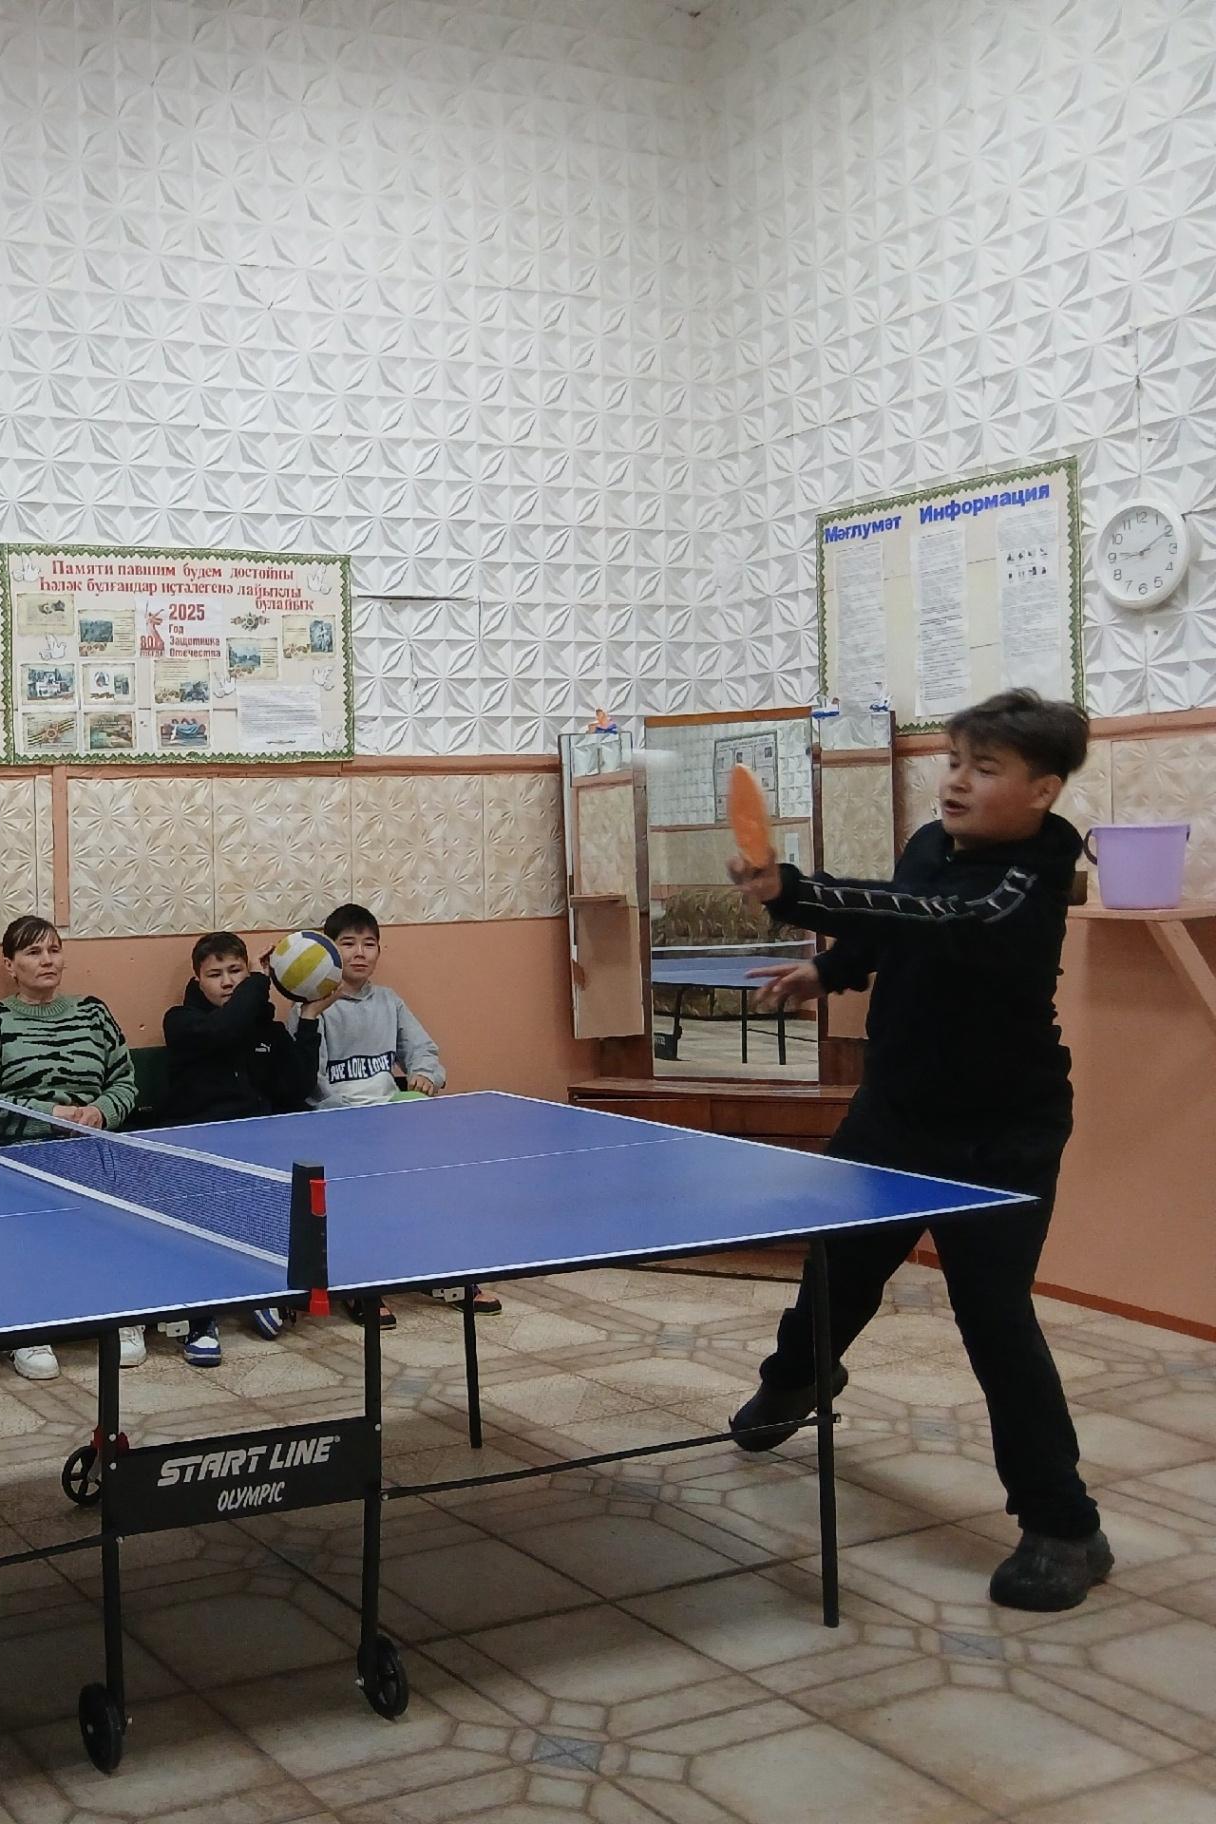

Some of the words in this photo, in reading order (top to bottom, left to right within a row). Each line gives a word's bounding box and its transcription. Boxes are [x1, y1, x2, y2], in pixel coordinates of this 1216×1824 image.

[919, 484, 1051, 524] Информация
[1136, 511, 1148, 523] 12
[1164, 525, 1173, 537] 2
[1111, 533, 1123, 545] 10
[1168, 543, 1178, 554] 3
[1107, 552, 1117, 564] 9
[52, 560, 114, 575] Памяти
[118, 563, 176, 577] павшим
[183, 562, 222, 581] будем
[230, 566, 294, 580] достойны
[1164, 561, 1173, 571] 4
[1113, 569, 1122, 581] 8
[1125, 580, 1133, 592] 7
[1153, 576, 1163, 588] 5
[1138, 583, 1148, 595] 6
[169, 603, 205, 621] 2025
[169, 623, 184, 634] Год
[347, 1058, 368, 1078] LOVE
[368, 1055, 390, 1076] LOVE
[157, 1446, 268, 1486] START
[269, 1436, 335, 1471] LINE
[218, 1481, 285, 1512] OLYMPIC
